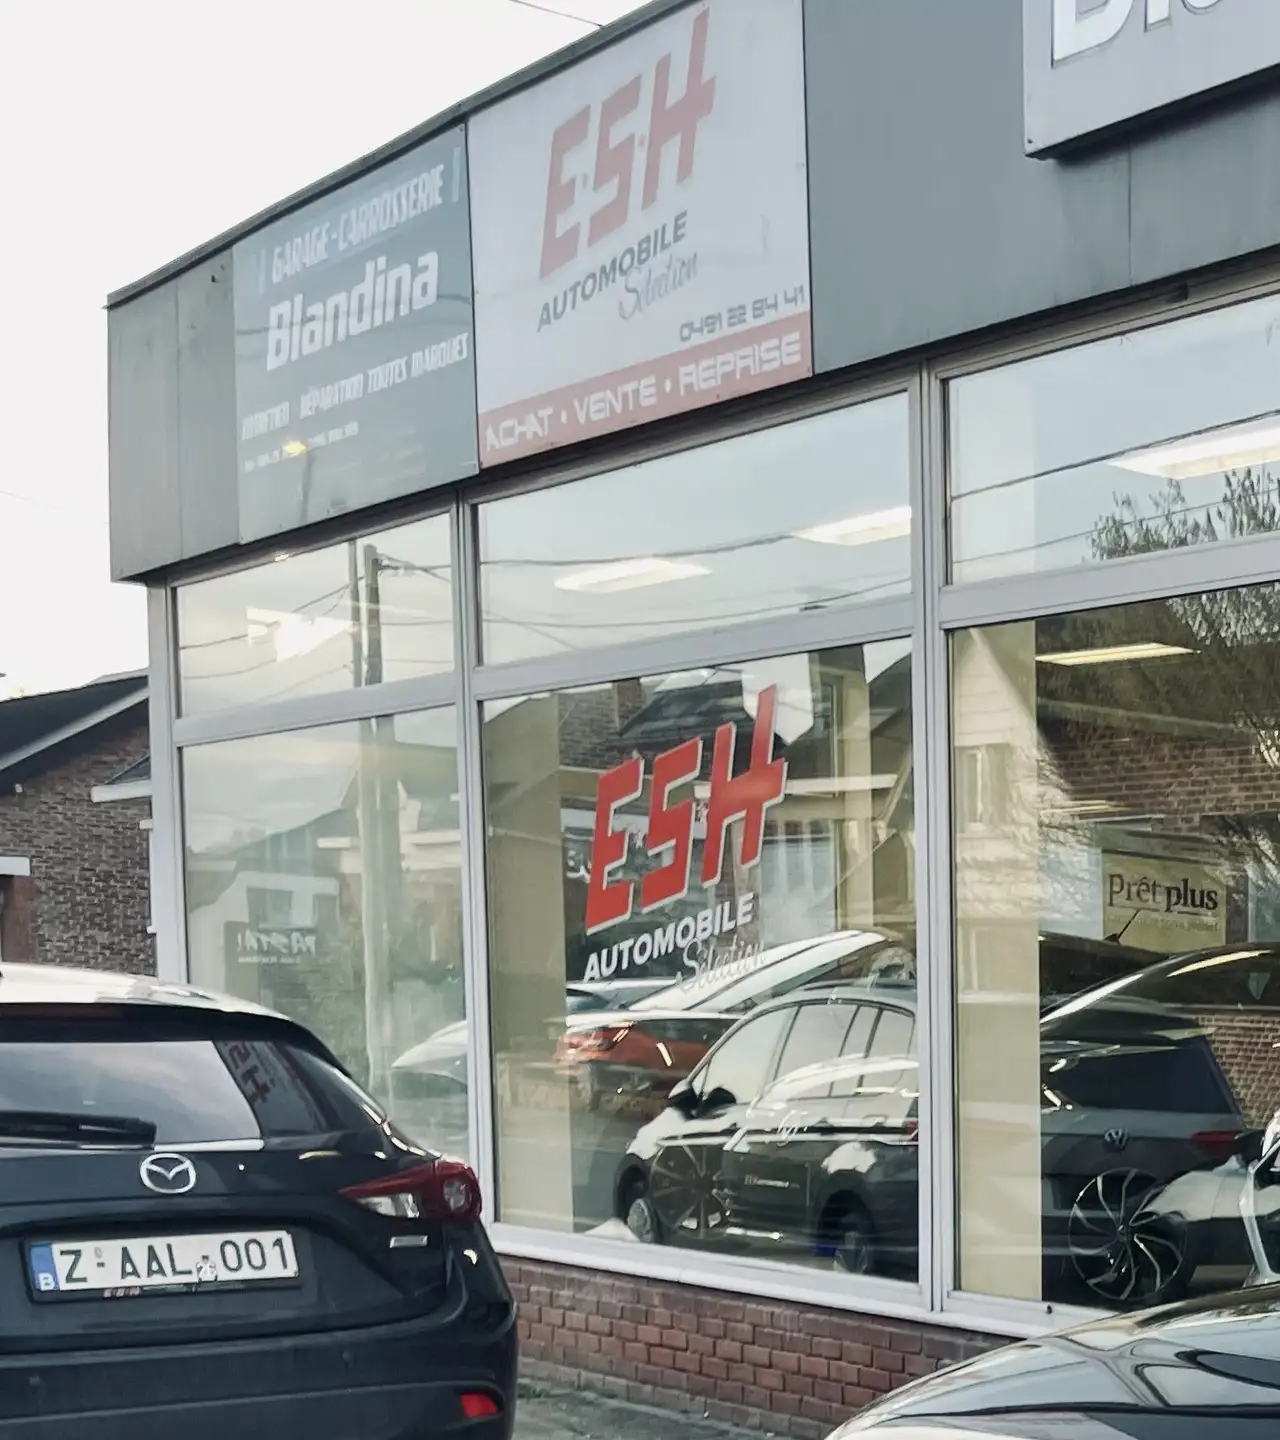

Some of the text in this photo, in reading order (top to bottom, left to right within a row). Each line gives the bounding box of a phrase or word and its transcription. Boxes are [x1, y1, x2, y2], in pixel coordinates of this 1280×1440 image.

[266, 251, 439, 371] Blandina
[537, 210, 688, 332] AUTOMOBILE
[680, 313, 722, 342] 0491
[727, 305, 747, 328] 22
[784, 285, 806, 309] 41
[485, 330, 802, 452] ACHAT VENTE REPRISE
[585, 683, 788, 936] ESH
[582, 892, 755, 983] AUTOMOBILE
[1108, 873, 1219, 913] Prêt plus
